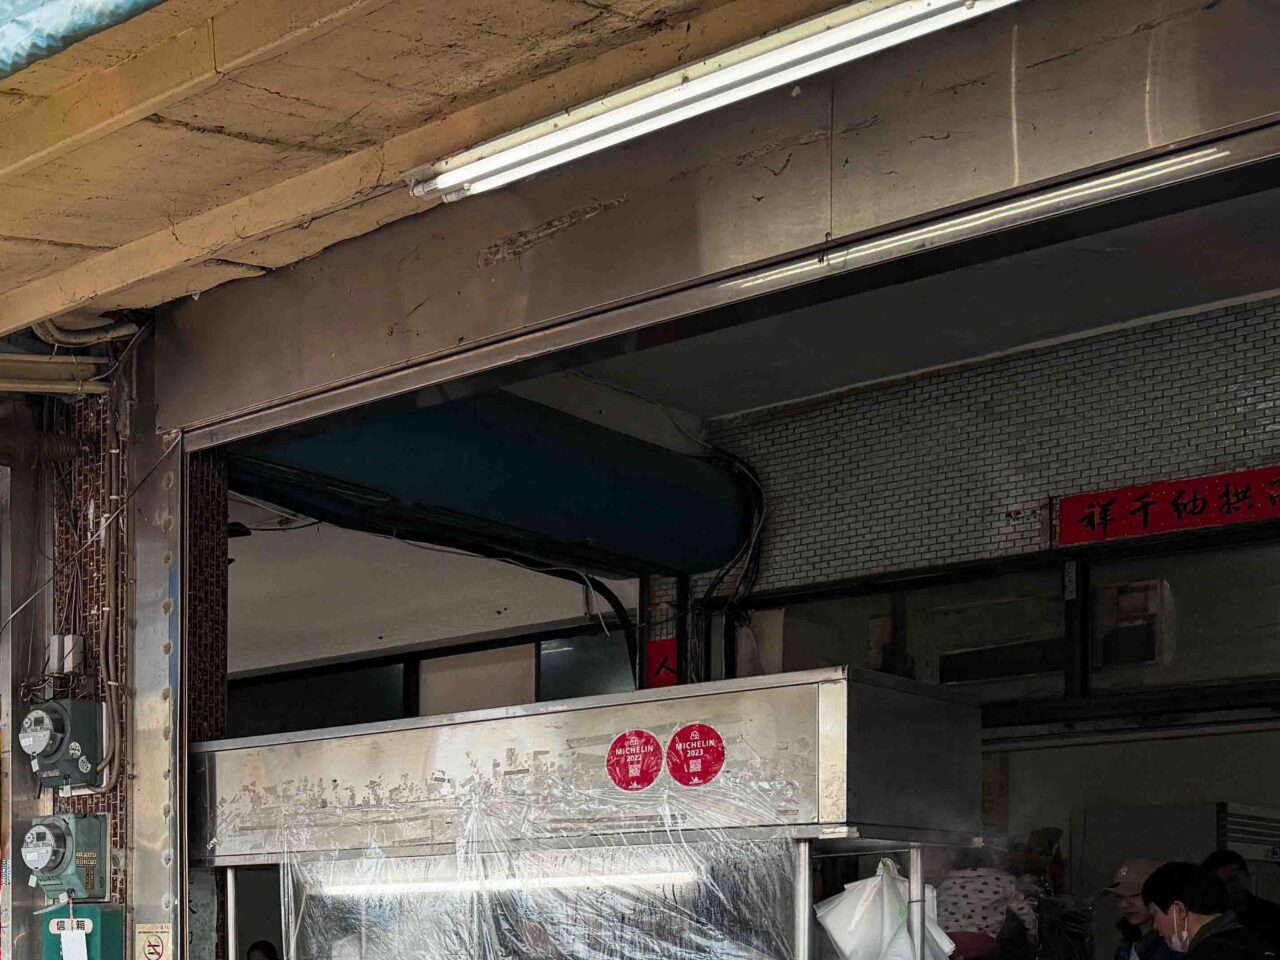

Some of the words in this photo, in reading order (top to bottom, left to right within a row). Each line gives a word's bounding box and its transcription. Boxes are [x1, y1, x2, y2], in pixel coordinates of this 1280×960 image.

[675, 738, 717, 750] MICHELIN
[615, 744, 654, 756] MICHELIN
[686, 749, 704, 758] 2023
[56, 920, 86, 931] 信箱
